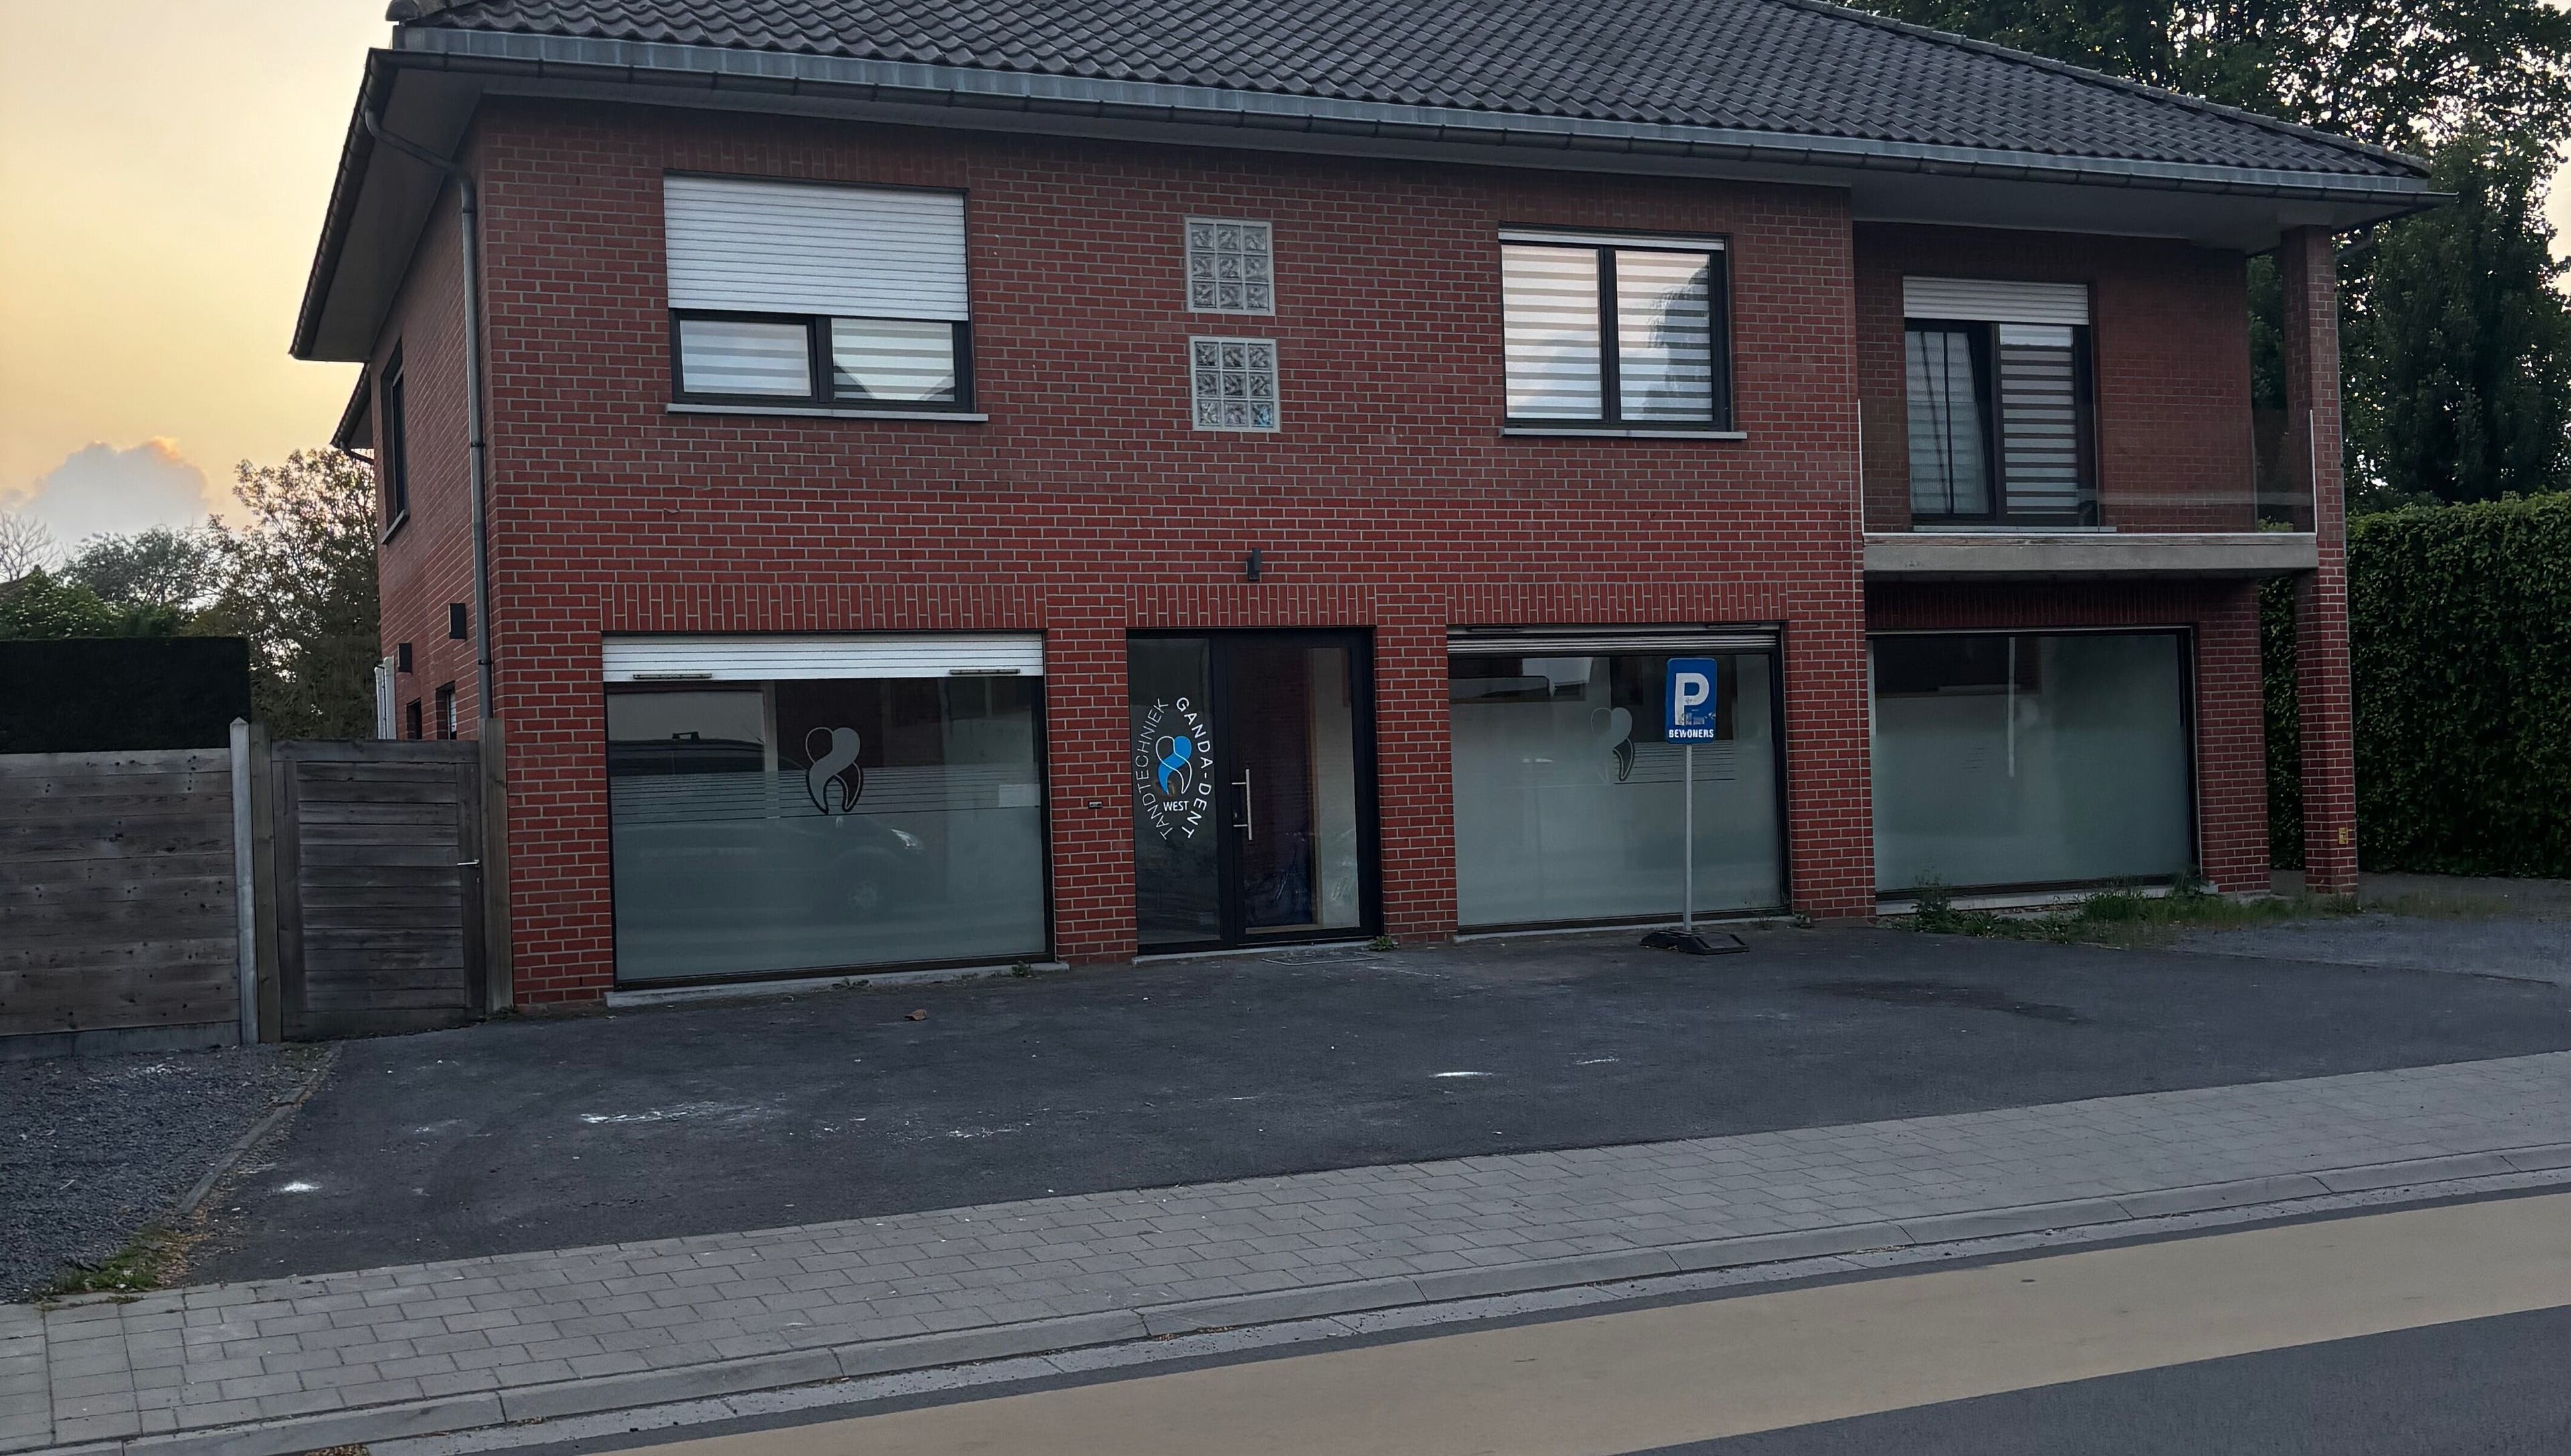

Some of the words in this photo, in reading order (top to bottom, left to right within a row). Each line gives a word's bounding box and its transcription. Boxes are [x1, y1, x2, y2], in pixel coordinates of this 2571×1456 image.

[1674, 673, 1709, 726] P
[1668, 728, 1714, 738] BEWONERS
[1135, 698, 1173, 840] TANDTECHNIEK
[1176, 697, 1213, 839] GANDA-DENT
[1163, 801, 1189, 812] WEST
